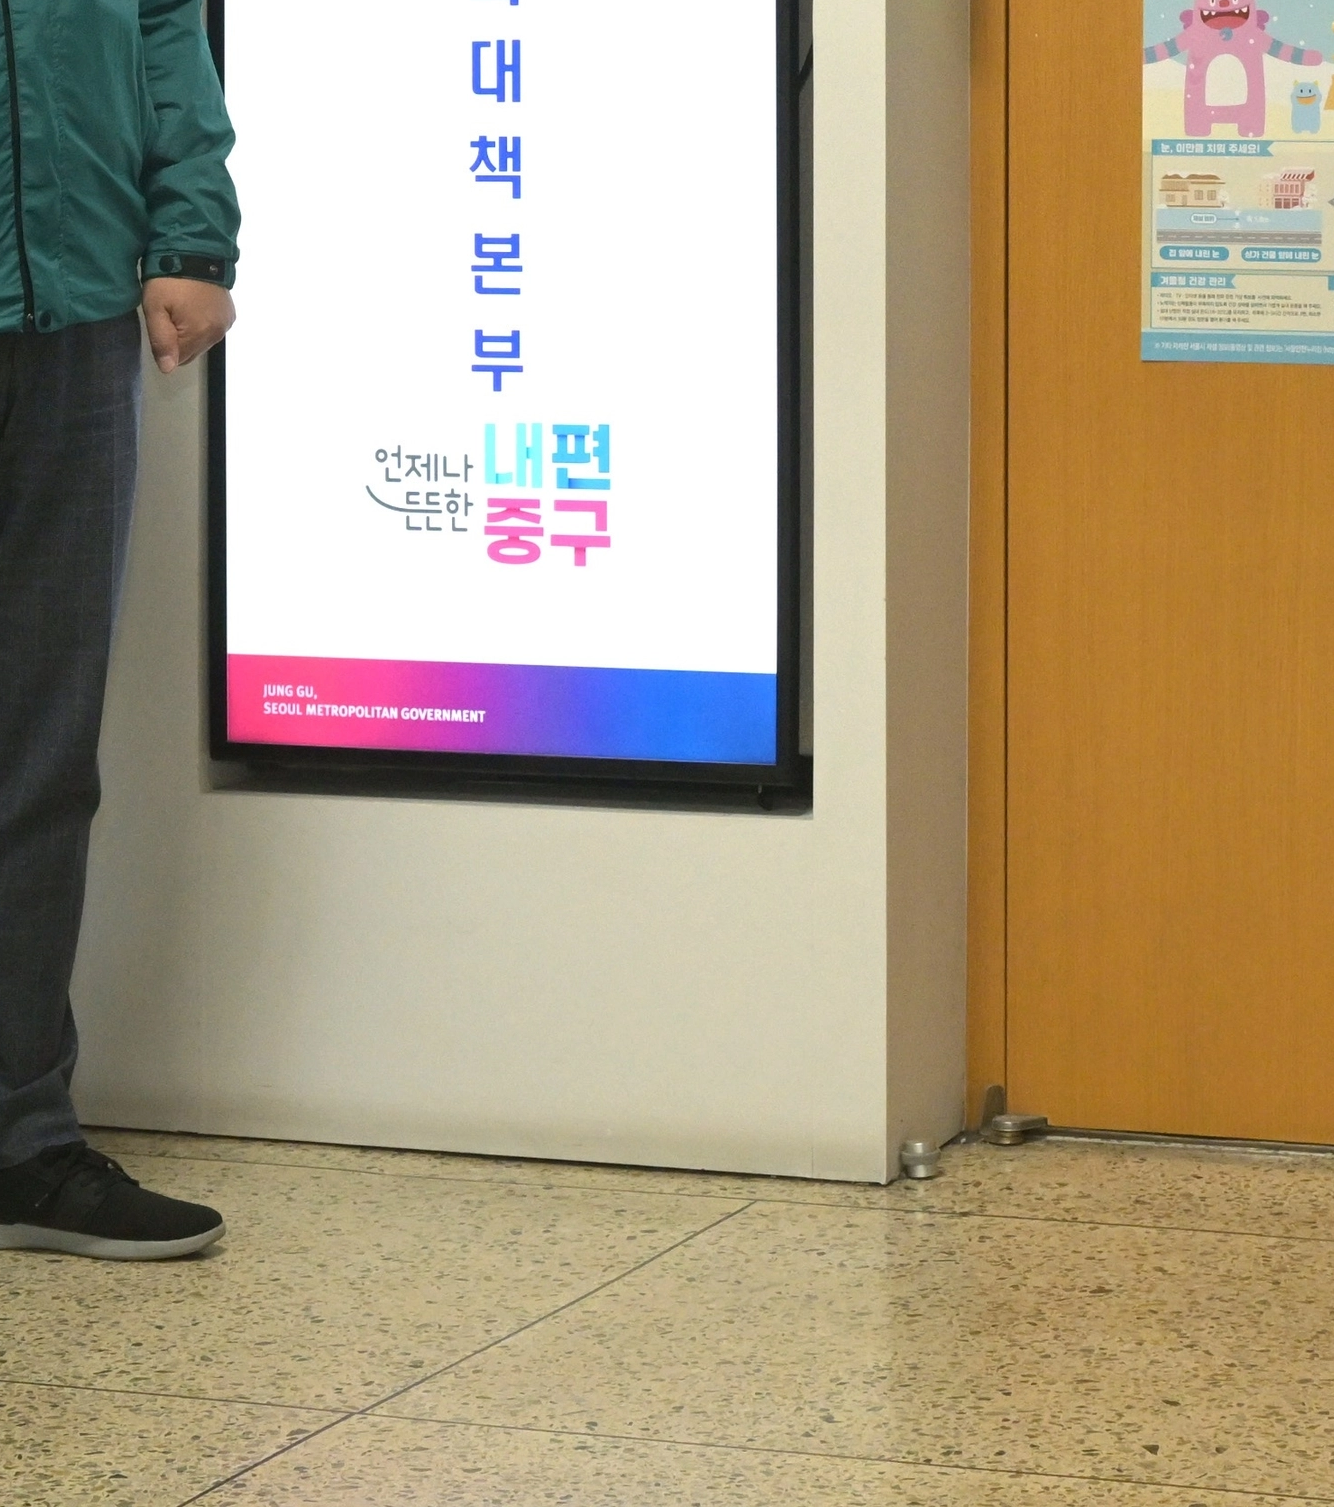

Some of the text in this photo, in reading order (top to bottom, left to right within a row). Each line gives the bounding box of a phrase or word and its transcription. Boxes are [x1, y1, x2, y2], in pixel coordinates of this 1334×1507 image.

[375, 444, 474, 483] 언제나
[484, 422, 611, 491] 내편
[484, 497, 612, 568] 중구
[263, 684, 318, 700] JUNG GU,
[263, 702, 486, 723] SEOUL METROPOLITAN GOVERNMENT
